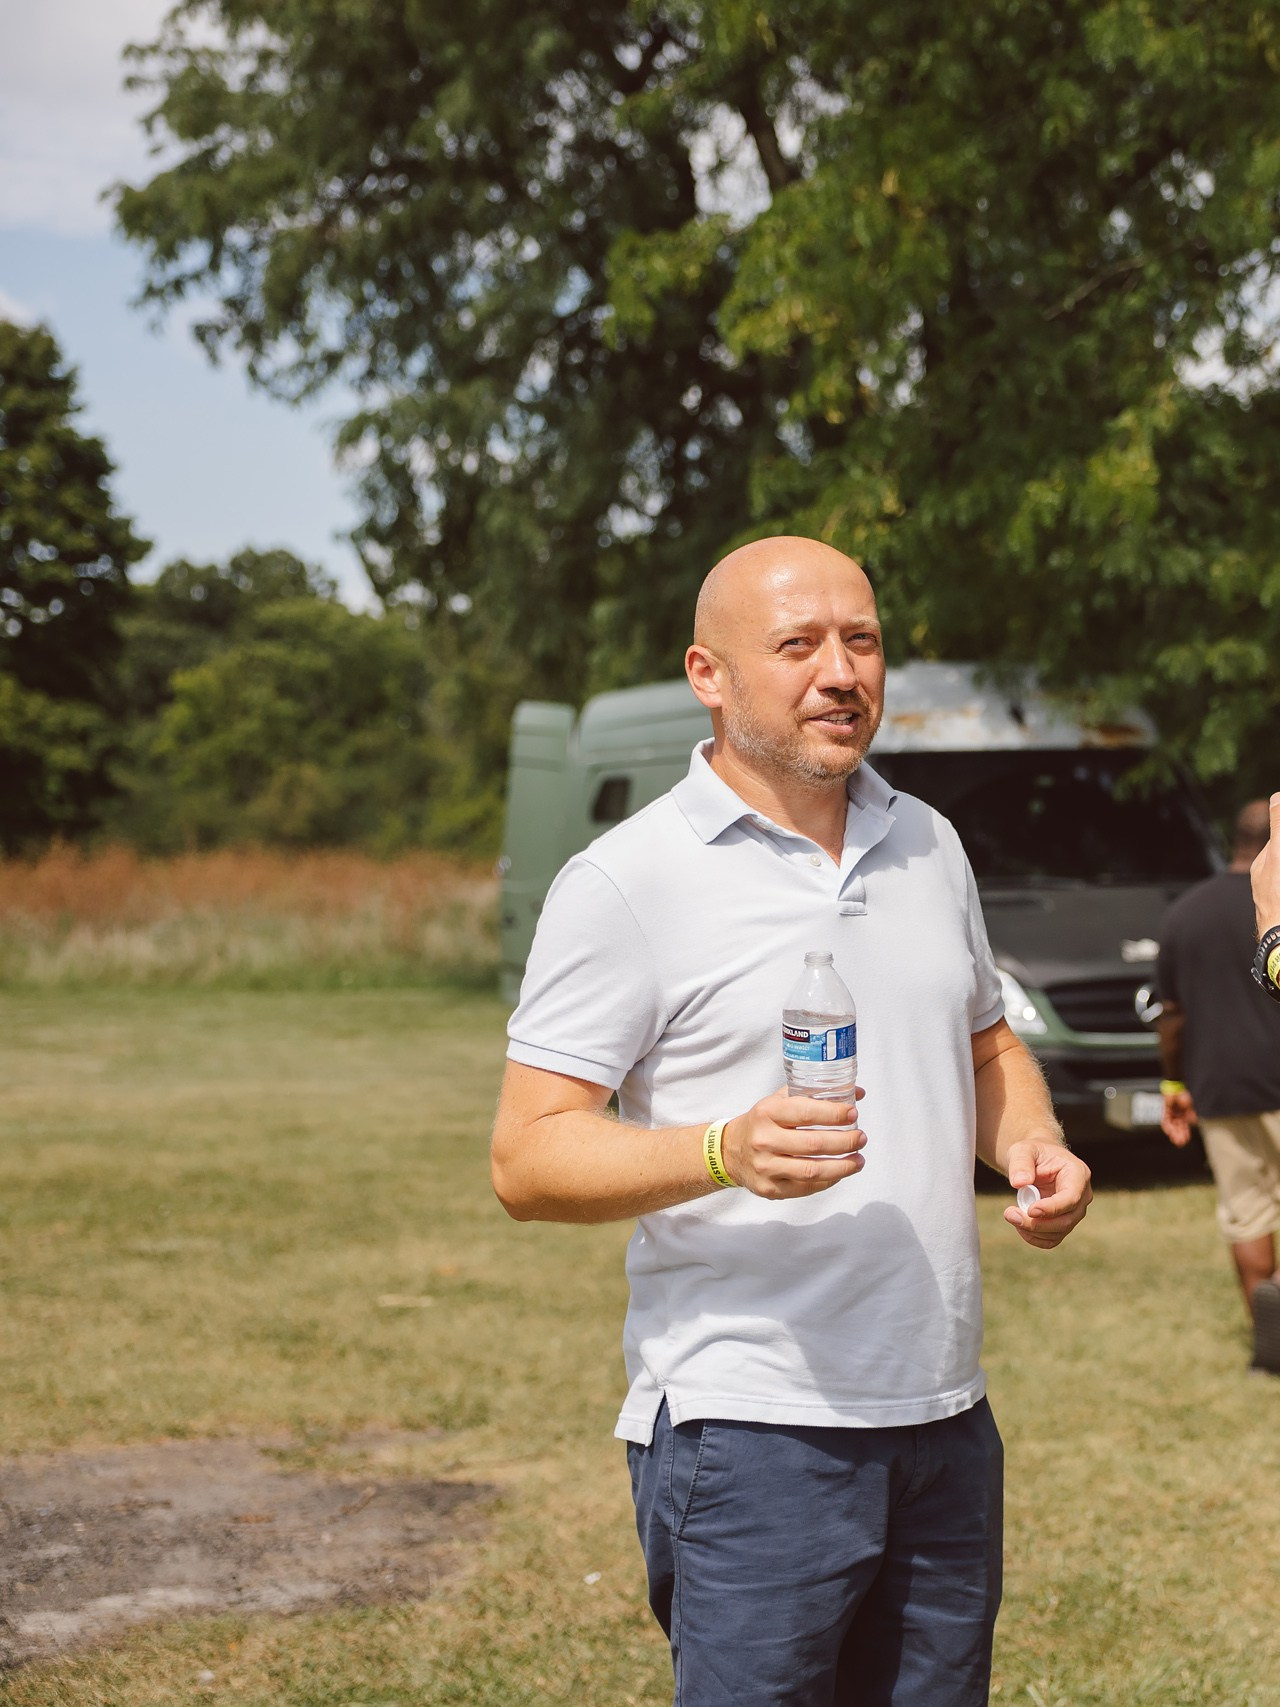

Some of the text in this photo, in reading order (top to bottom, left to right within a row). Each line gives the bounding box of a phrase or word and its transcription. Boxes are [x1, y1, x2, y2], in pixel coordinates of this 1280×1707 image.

[707, 1129, 728, 1184] PIT STOP PARTY
